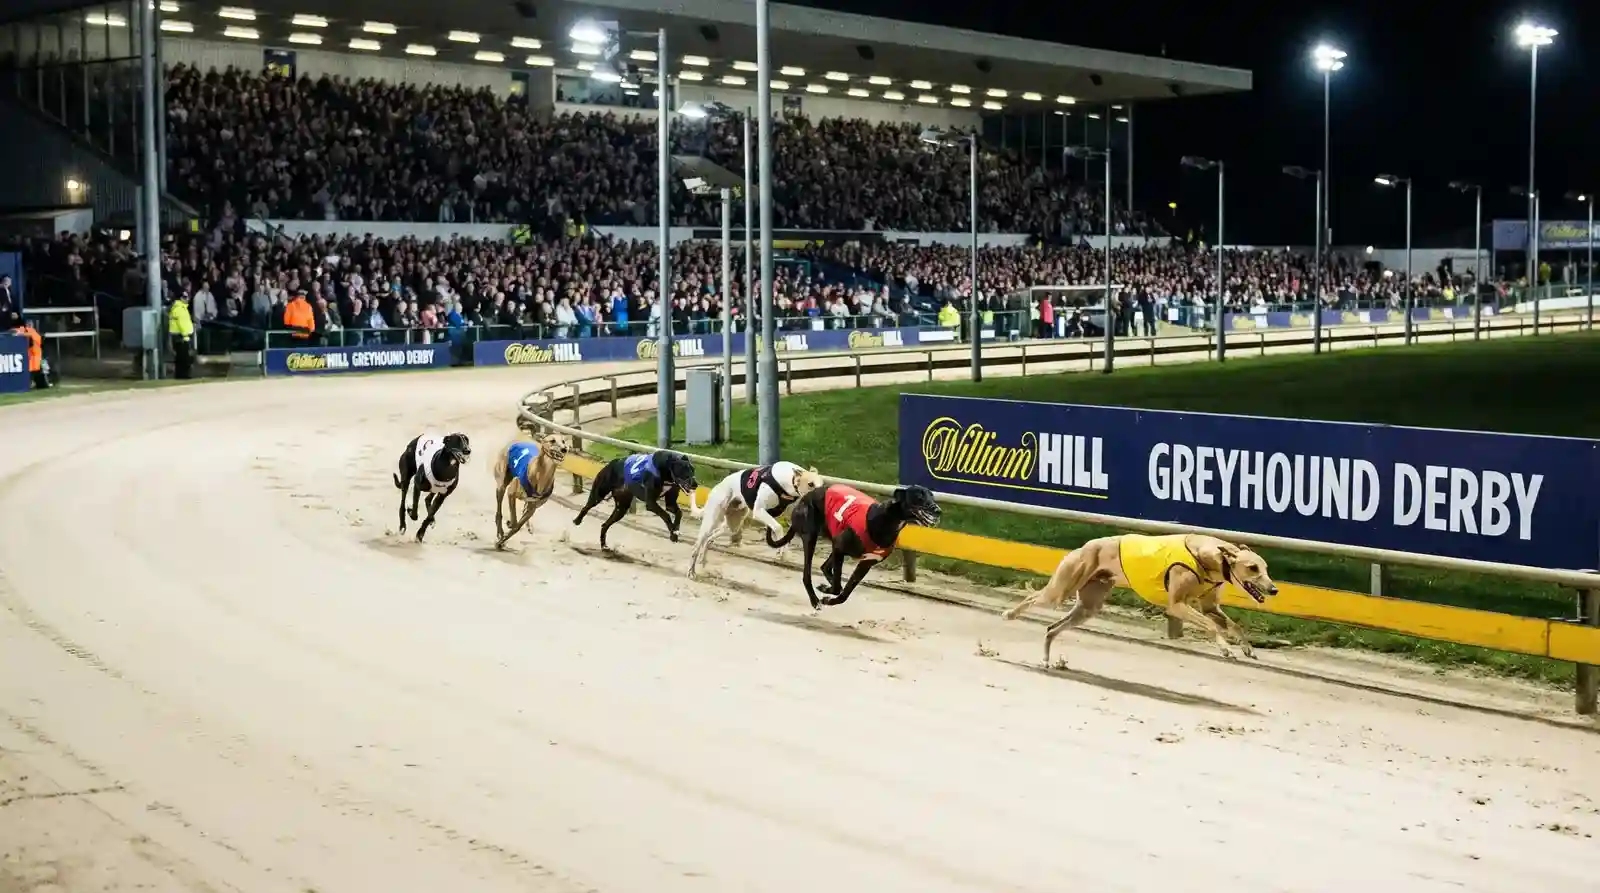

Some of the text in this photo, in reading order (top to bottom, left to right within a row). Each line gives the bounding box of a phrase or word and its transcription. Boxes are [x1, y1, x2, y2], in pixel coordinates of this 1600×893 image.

[352, 351, 404, 367] GREYHOUND
[407, 350, 434, 364] DERBY
[554, 343, 582, 361] HILL
[630, 455, 646, 474] 2
[923, 417, 1543, 540] William HILL GREYHOUND DERBY
[833, 495, 856, 522] 1
